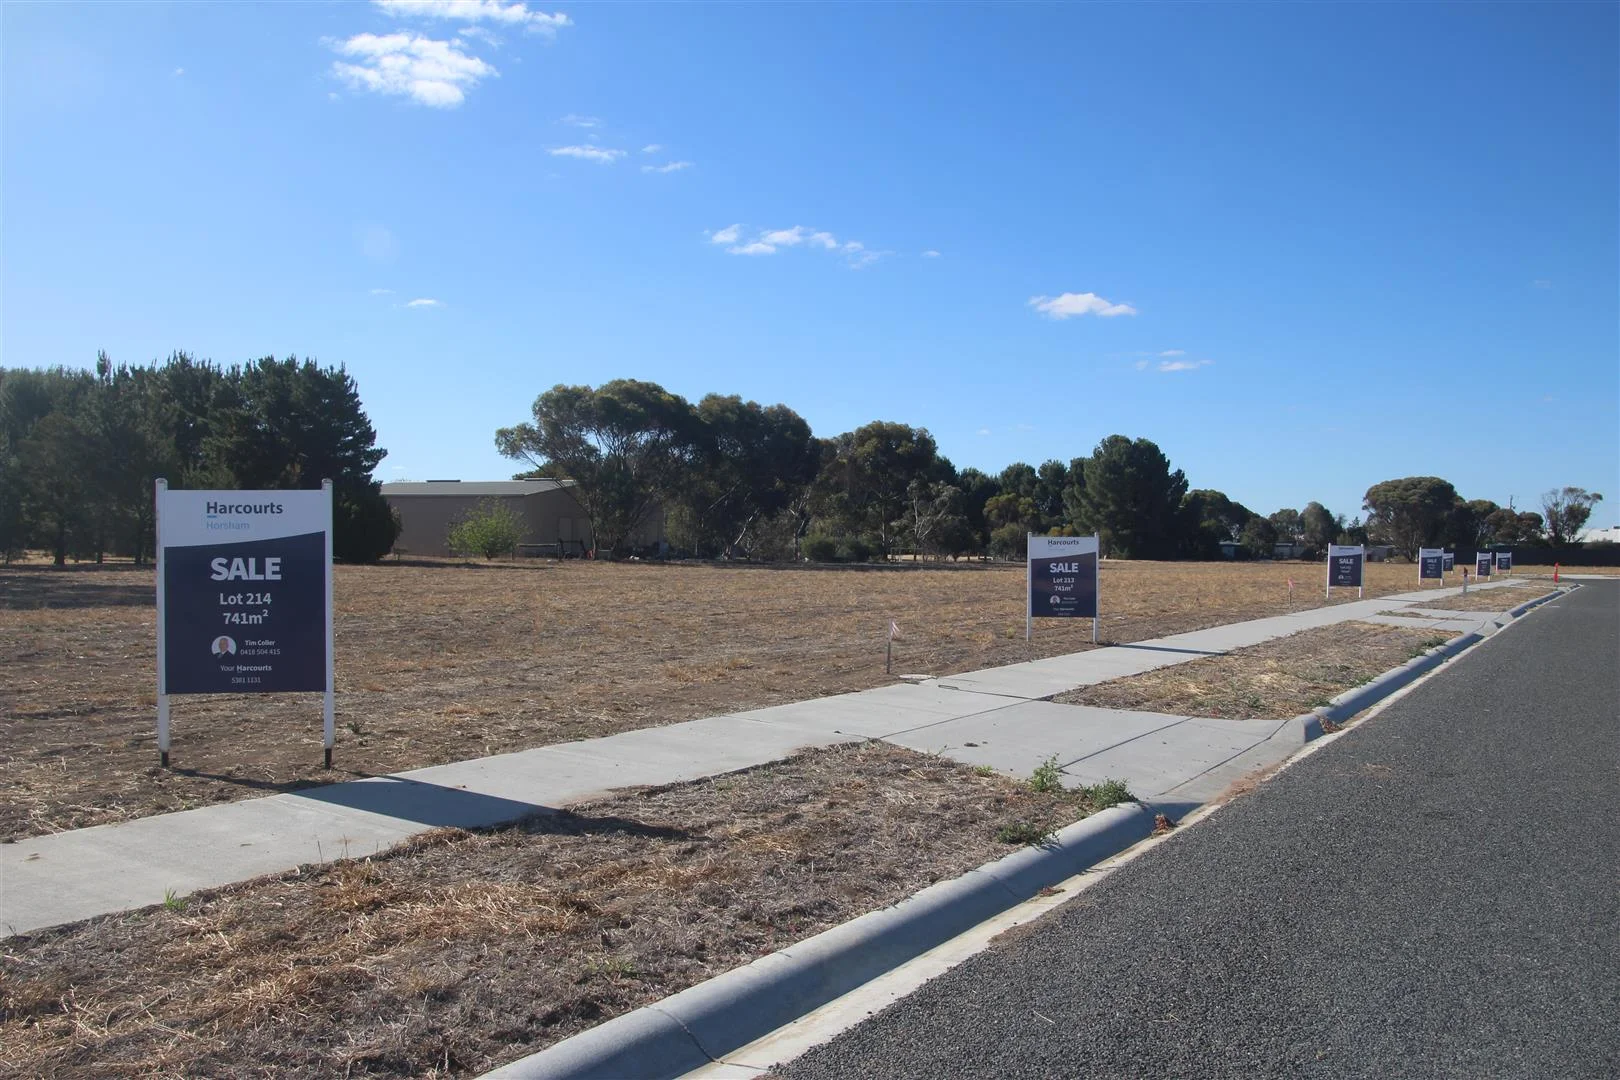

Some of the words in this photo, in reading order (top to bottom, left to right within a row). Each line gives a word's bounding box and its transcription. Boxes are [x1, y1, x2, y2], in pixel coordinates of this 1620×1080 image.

[206, 501, 283, 514] Harcourts
[206, 521, 250, 530] Horsham
[210, 557, 282, 581] SALE
[1050, 562, 1079, 573] SALE
[219, 593, 243, 605] Lot
[246, 593, 272, 605] 214
